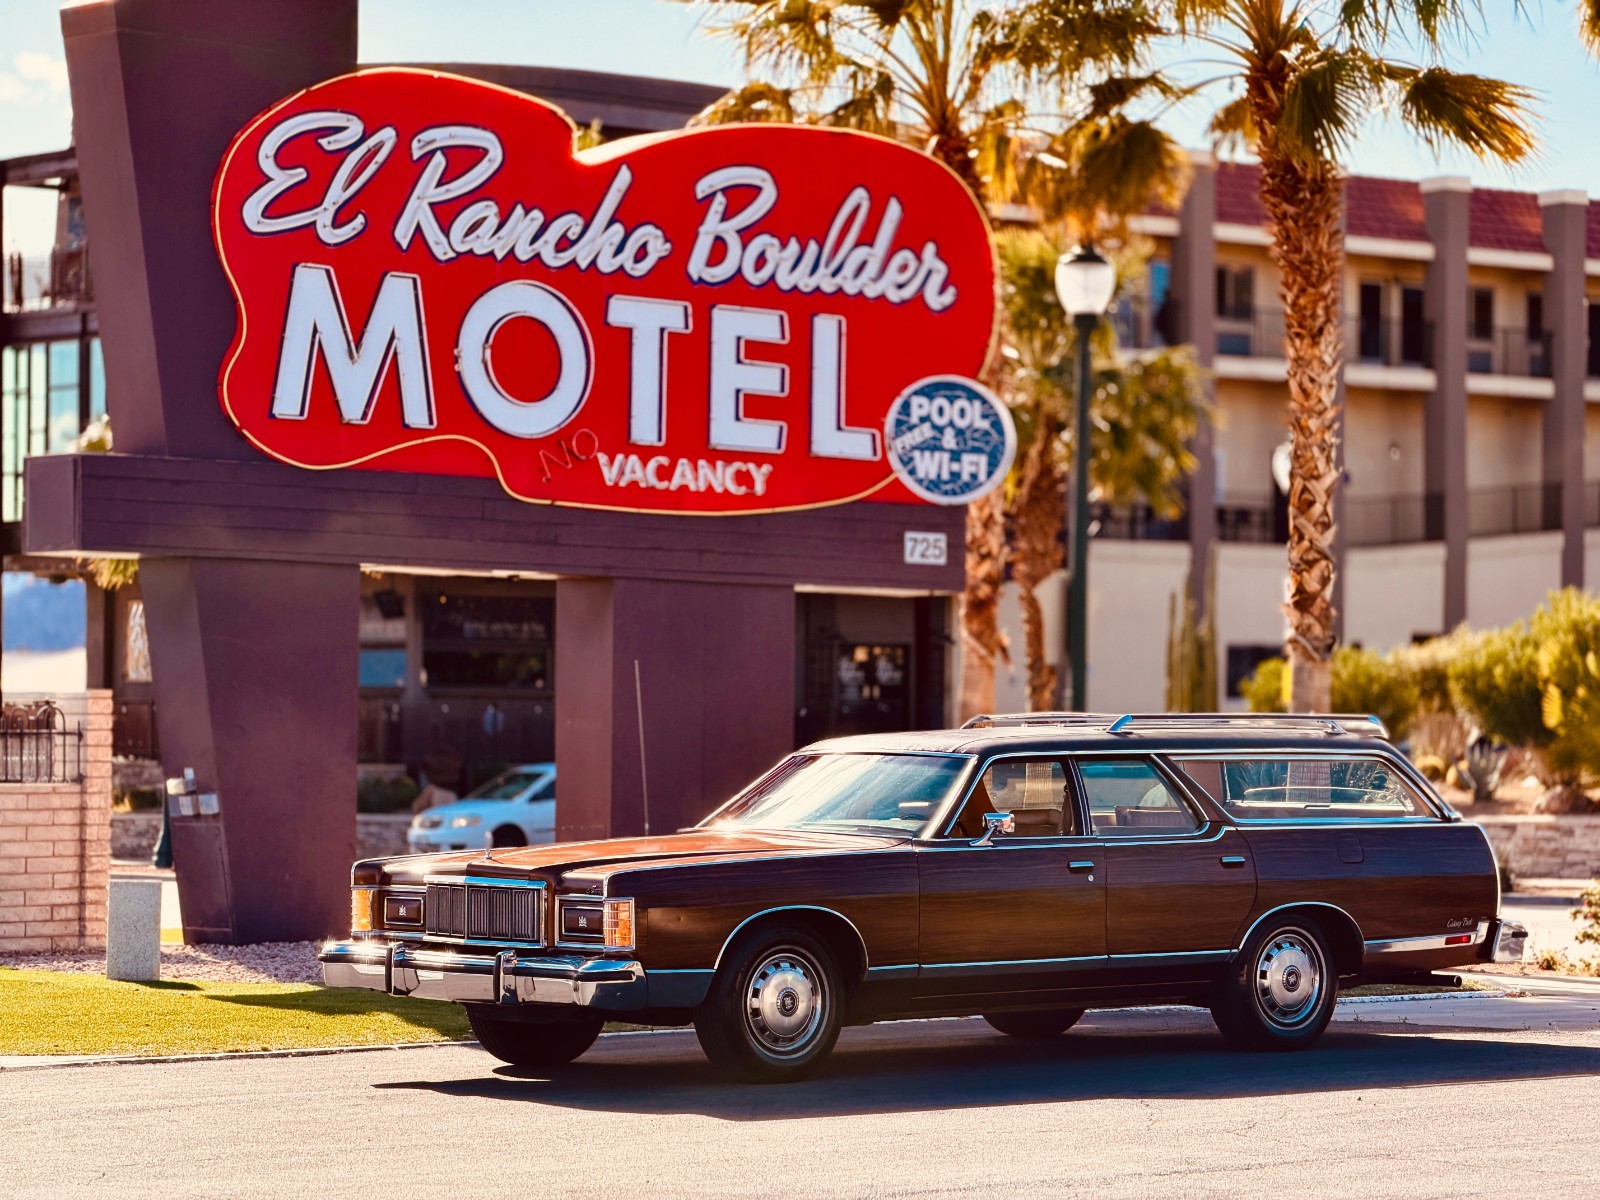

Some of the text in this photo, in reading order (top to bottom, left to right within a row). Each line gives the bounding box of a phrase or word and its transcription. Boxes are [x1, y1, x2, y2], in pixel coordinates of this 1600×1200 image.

[242, 110, 957, 312] El Rancho Boulder
[269, 263, 882, 460] MOTEL
[909, 395, 991, 429] POOL
[941, 427, 958, 450] &
[539, 428, 773, 496] NO VACANCY
[913, 450, 989, 482] WI-FI
[908, 538, 945, 561] 725
